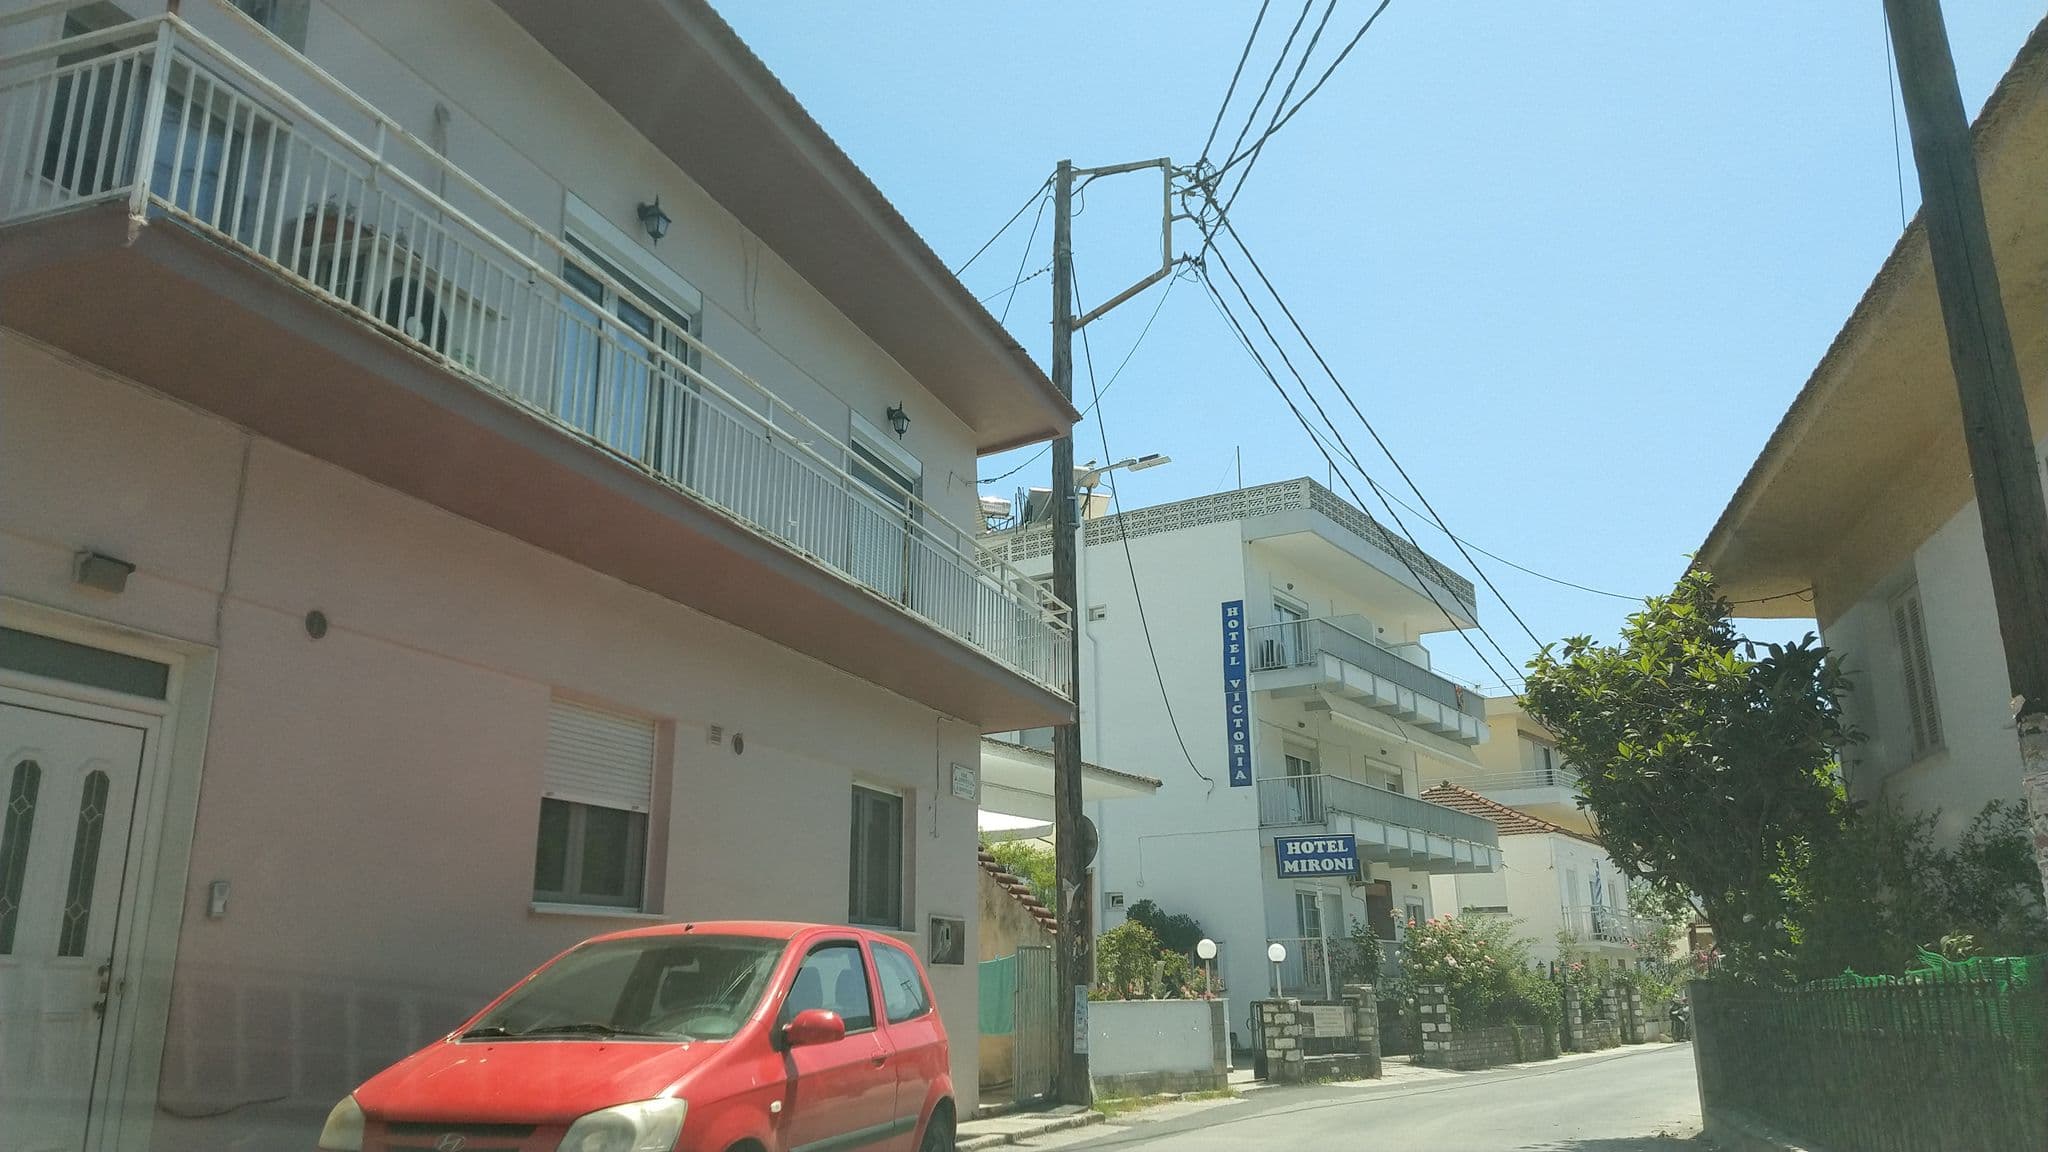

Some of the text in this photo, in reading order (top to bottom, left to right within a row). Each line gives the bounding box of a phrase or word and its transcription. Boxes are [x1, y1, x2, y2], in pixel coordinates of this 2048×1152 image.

[1227, 606, 1247, 781] HOTEL VICTORIA
[1286, 839, 1349, 855] HOTEL
[1284, 857, 1354, 873] MIRONI
